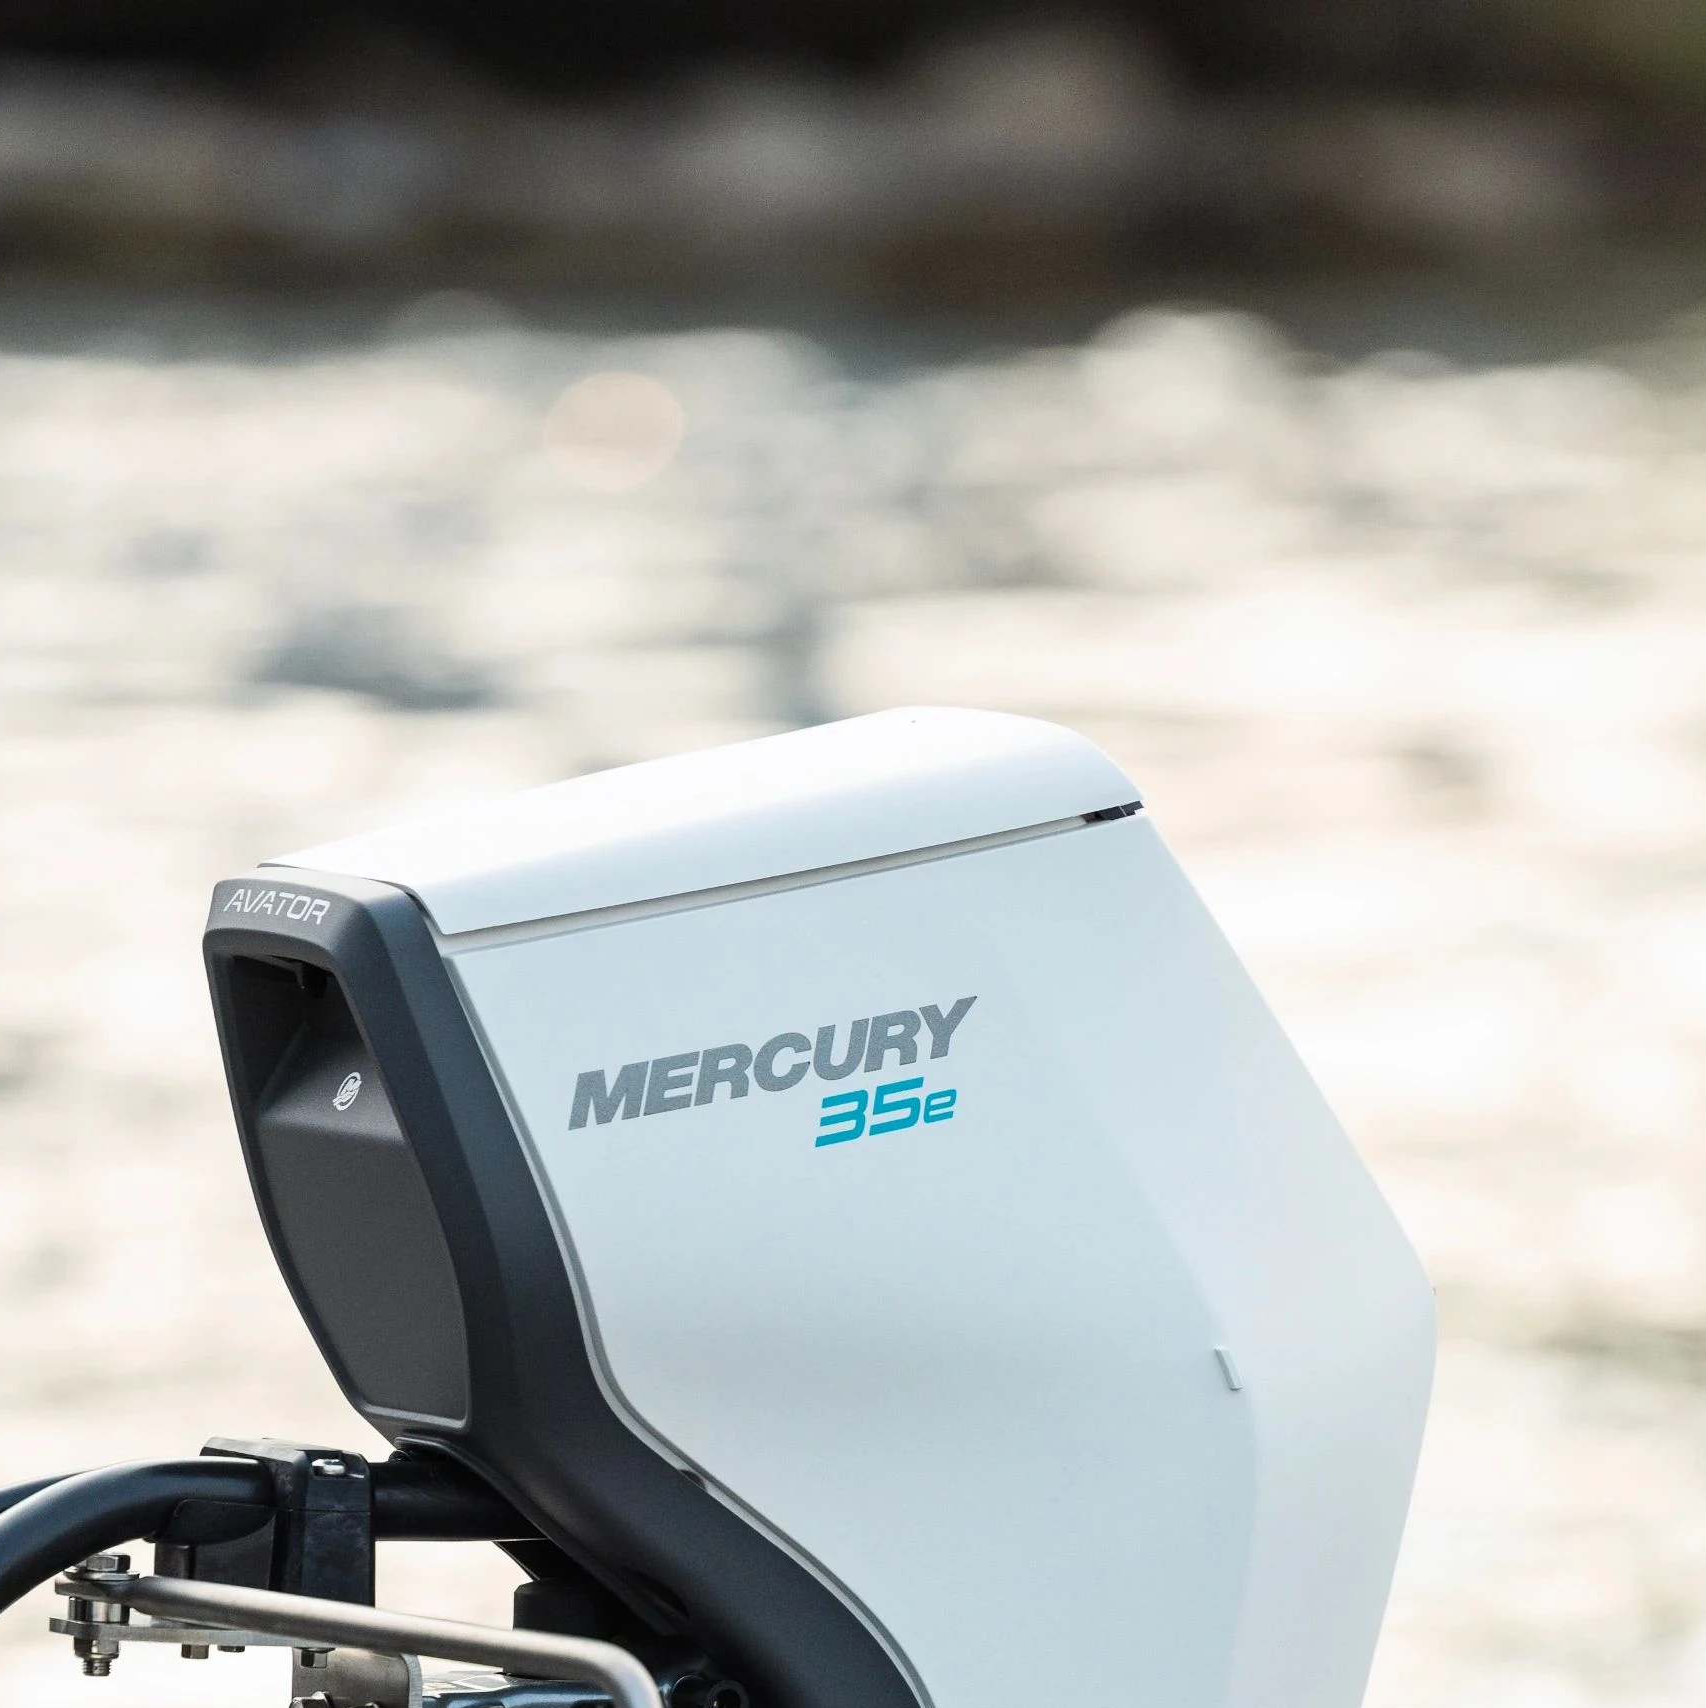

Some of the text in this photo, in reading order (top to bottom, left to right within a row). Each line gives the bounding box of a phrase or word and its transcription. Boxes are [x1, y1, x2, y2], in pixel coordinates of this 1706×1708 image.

[223, 888, 330, 925] AVATOR
[568, 996, 978, 1130] MERCURY
[815, 1077, 957, 1147] 35e
